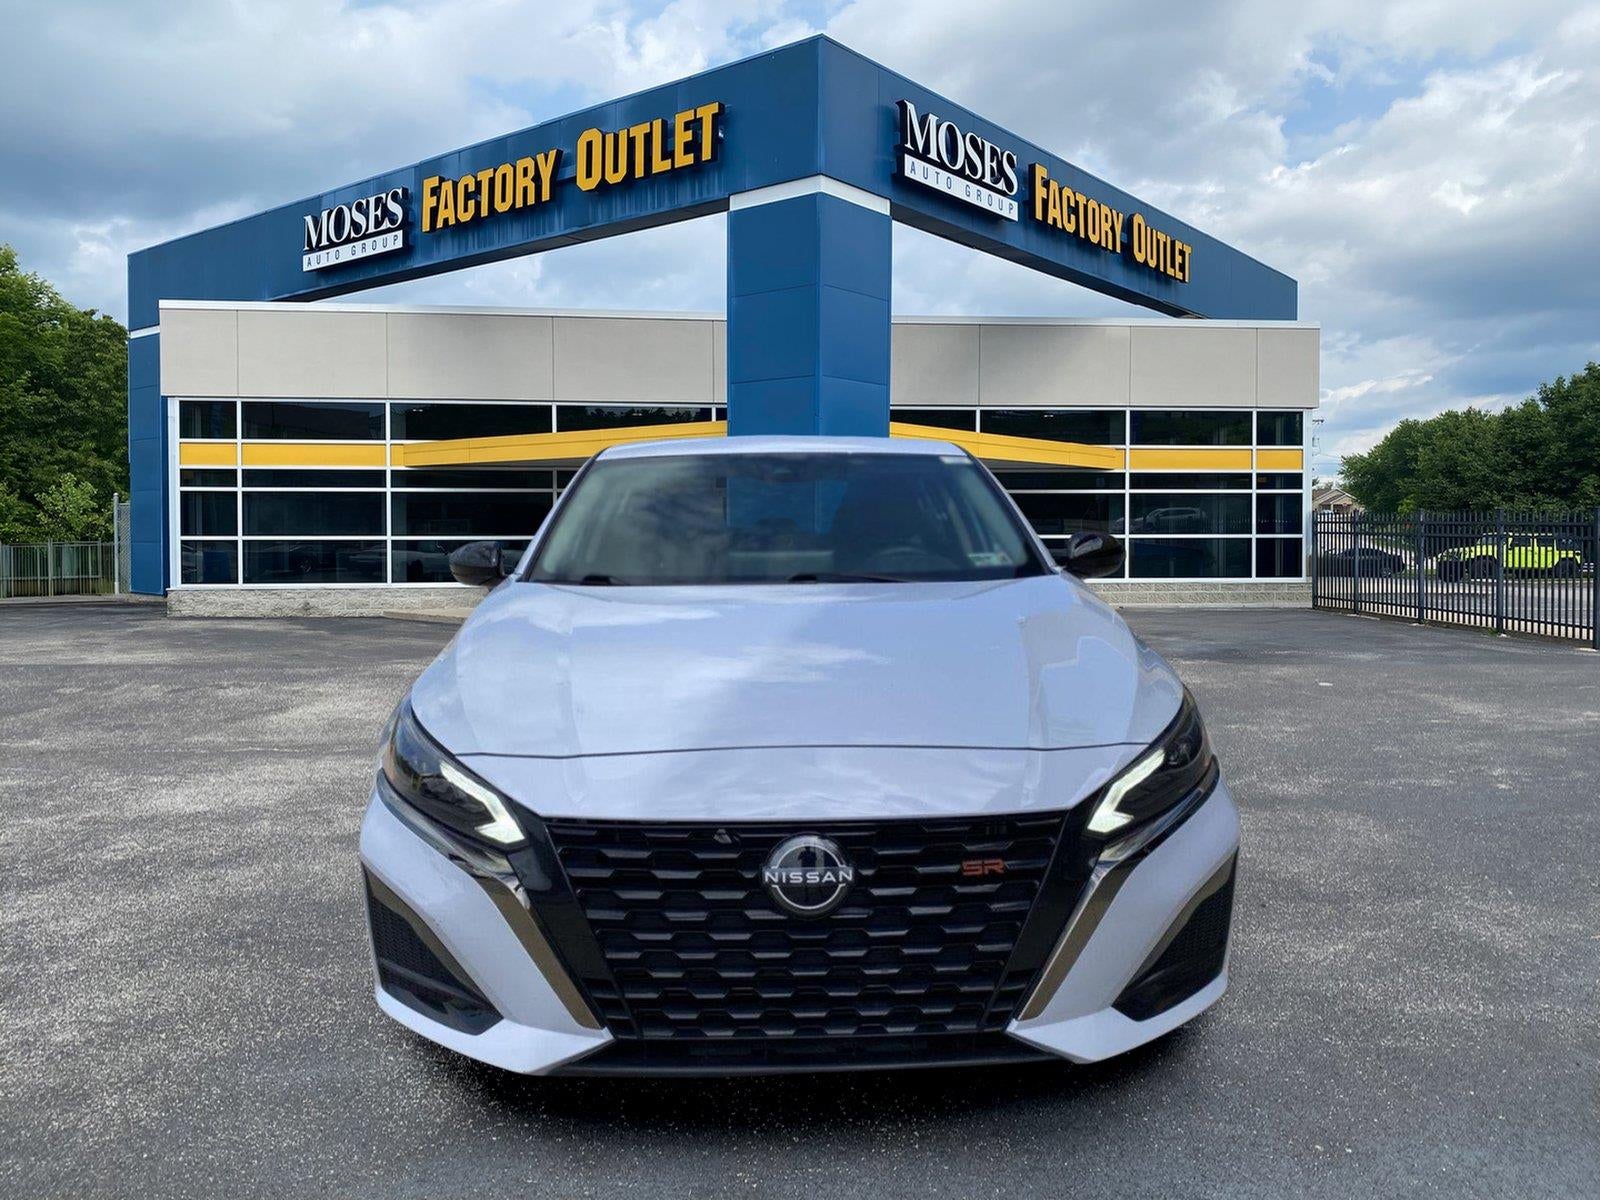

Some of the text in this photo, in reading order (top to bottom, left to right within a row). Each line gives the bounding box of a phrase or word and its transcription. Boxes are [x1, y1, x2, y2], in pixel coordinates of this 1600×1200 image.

[421, 101, 720, 233] FACTORY OUTLET
[904, 99, 1018, 196] MOSES
[910, 160, 1015, 214] AUTO GROUP
[303, 187, 404, 252] MOSES
[1034, 162, 1192, 283] FACTORY OUTLET
[306, 234, 400, 268] AUTO GROUP
[764, 869, 853, 884] NISSAN
[961, 858, 1006, 876] SR
